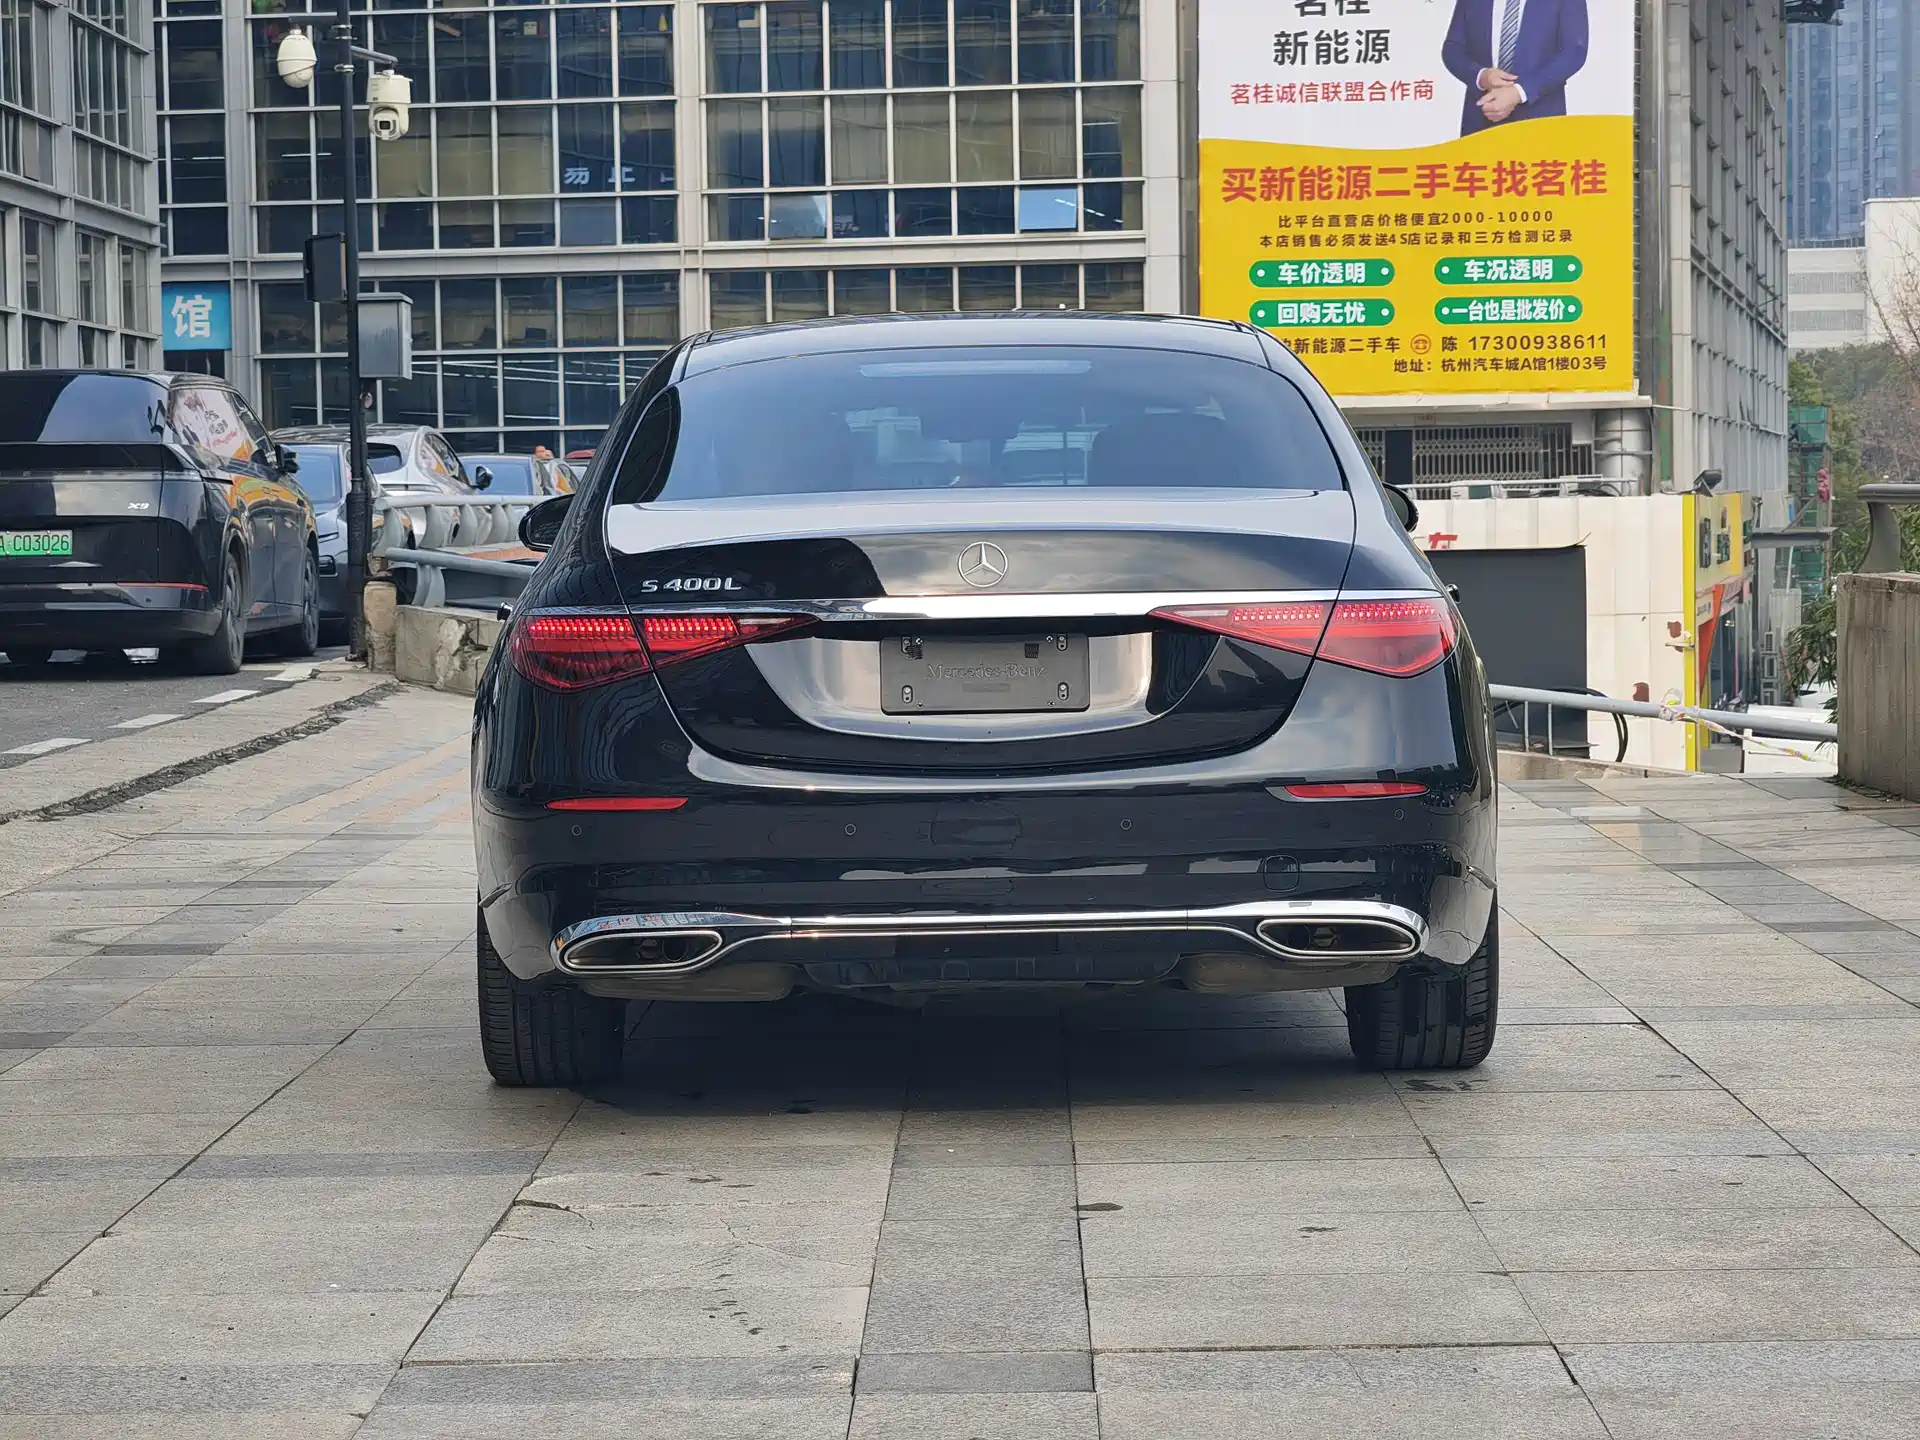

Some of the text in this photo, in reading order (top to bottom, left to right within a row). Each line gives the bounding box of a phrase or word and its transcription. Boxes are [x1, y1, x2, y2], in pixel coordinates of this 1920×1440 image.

[1273, 29, 1391, 66] 新能源
[1230, 79, 1435, 105] 茗桂诚信联盟合作商
[1221, 159, 1608, 203] 买新能源二手车找茗桂
[1278, 262, 1366, 285] 车价透明
[1464, 258, 1553, 282] 车况透明
[171, 294, 212, 338] 馆
[1277, 301, 1366, 324] 回购无忧
[1452, 298, 1565, 322] 一台也是批发价
[1441, 335, 1458, 353] 陈
[1468, 333, 1607, 352] 17300938611
[128, 502, 150, 510] X9
